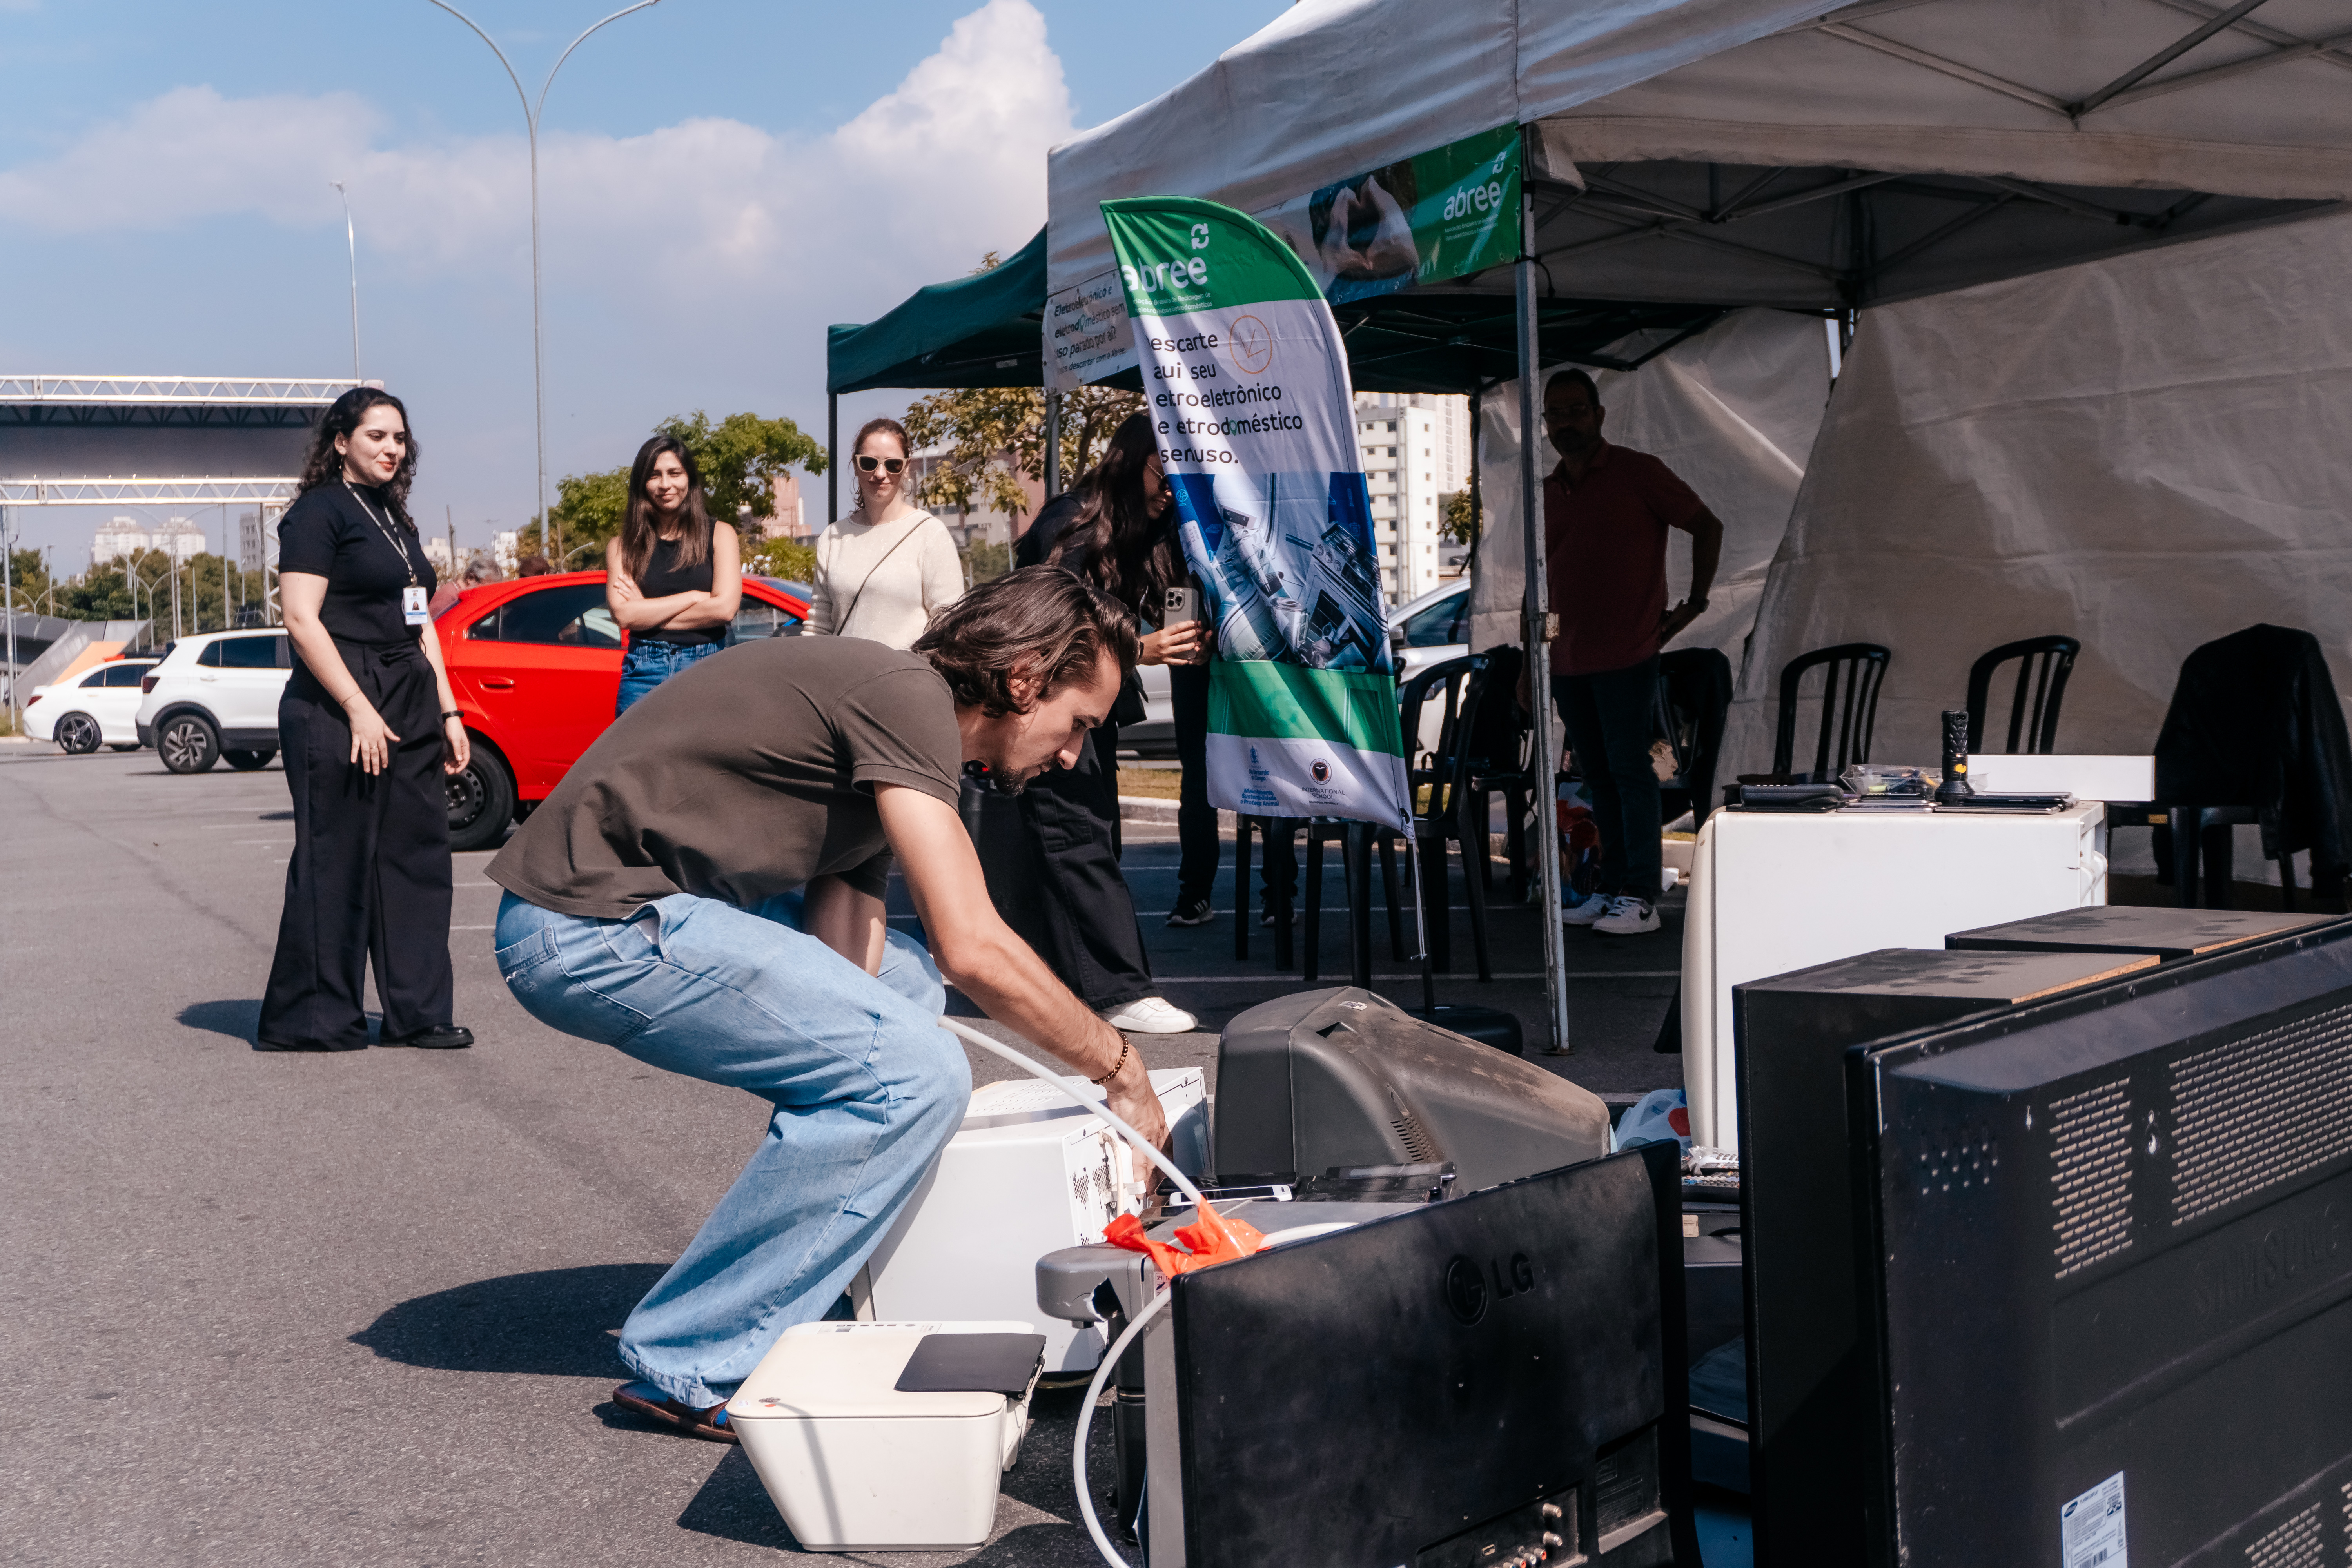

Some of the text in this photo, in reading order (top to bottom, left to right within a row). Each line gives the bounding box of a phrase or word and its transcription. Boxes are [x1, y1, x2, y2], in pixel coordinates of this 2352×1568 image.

[1444, 181, 1501, 220] abree
[1121, 257, 1208, 292] abree
[1111, 303, 1125, 316] sem
[1070, 336, 1094, 358] parado
[1094, 332, 1106, 349] por
[1145, 333, 1218, 352] escarte
[1069, 358, 1095, 370] descartar
[1191, 364, 1216, 379] seu
[1158, 420, 1169, 434] e
[1491, 1254, 1536, 1301] LG
